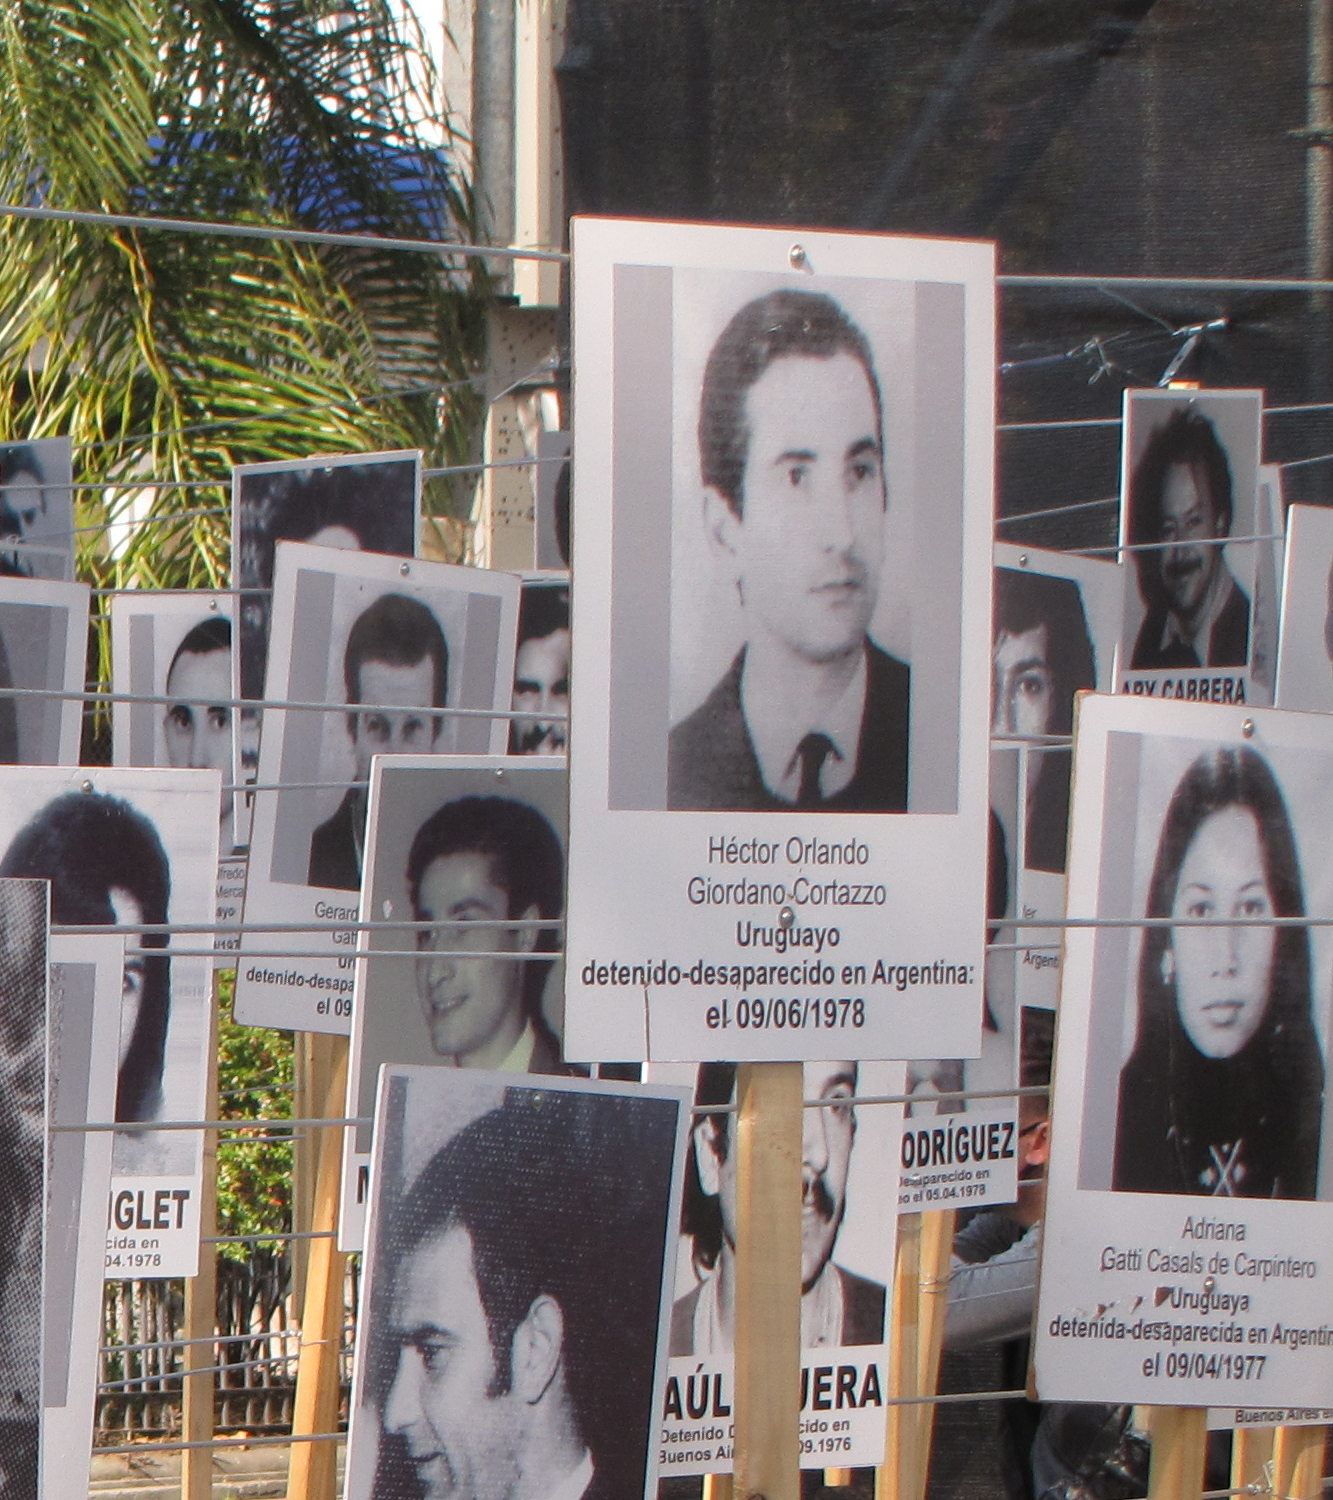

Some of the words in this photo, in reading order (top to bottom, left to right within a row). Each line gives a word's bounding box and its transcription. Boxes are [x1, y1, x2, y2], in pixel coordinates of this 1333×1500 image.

[708, 836, 780, 865] Héctor
[785, 836, 870, 865] Orlando
[687, 876, 785, 906] Giordano
[792, 877, 886, 907] Cortazzo
[314, 901, 358, 923] Gerard
[736, 921, 841, 953] Uruguayo
[1023, 950, 1060, 970] Argent
[246, 966, 354, 994] detenido-desapa
[581, 960, 834, 992] detenido-desaparecido
[841, 967, 866, 985] en
[871, 960, 975, 993] Argentina:
[317, 997, 330, 1014] el
[705, 1000, 728, 1029] el
[736, 998, 865, 1029] 09/06/1978
[901, 1118, 1015, 1169] ODRÍGUEZ
[108, 1190, 190, 1230] GLET
[1182, 1215, 1247, 1242] Adriana
[141, 1239, 159, 1249] en
[105, 1254, 161, 1267] 04.1978
[1101, 1246, 1142, 1271] Gatti
[1147, 1248, 1203, 1273] Casals
[1208, 1252, 1229, 1275] de
[1234, 1252, 1317, 1281] Carpintero
[1171, 1287, 1250, 1316] Uruguaya
[1049, 1315, 1243, 1347] detenida-desaparecida
[1248, 1326, 1267, 1344] en
[1270, 1323, 1333, 1351] Argentin
[1142, 1352, 1159, 1377] el
[1166, 1353, 1267, 1380] 09/04/1977
[663, 1363, 731, 1421] AÚL
[833, 1420, 850, 1432] en
